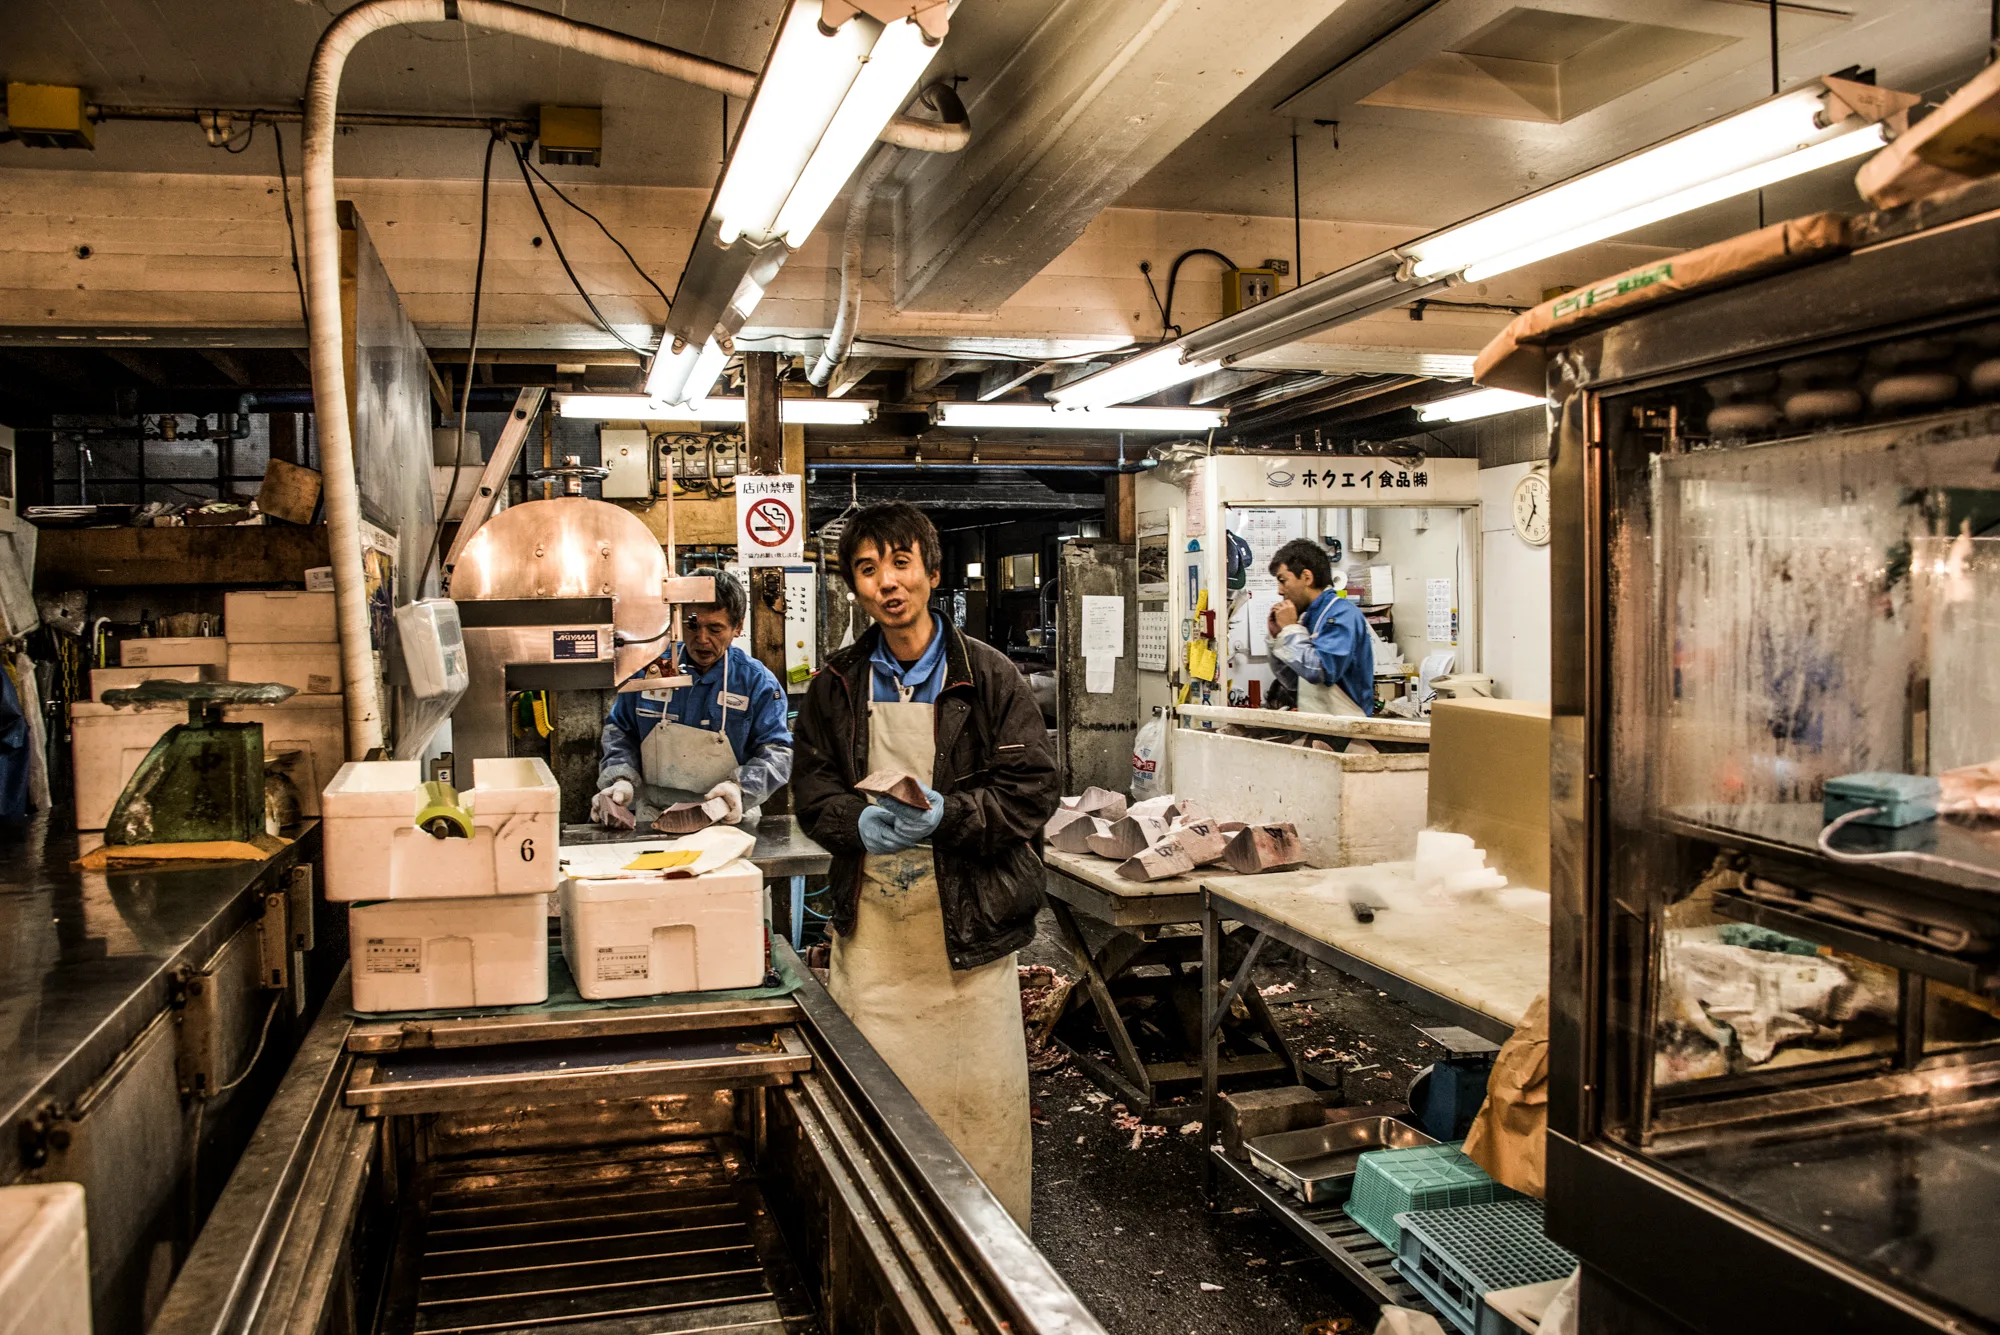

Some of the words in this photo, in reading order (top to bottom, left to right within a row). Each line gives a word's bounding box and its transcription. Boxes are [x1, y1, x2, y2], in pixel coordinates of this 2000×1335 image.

[743, 482, 795, 494] 店内禁煙
[520, 838, 535, 862] 6
